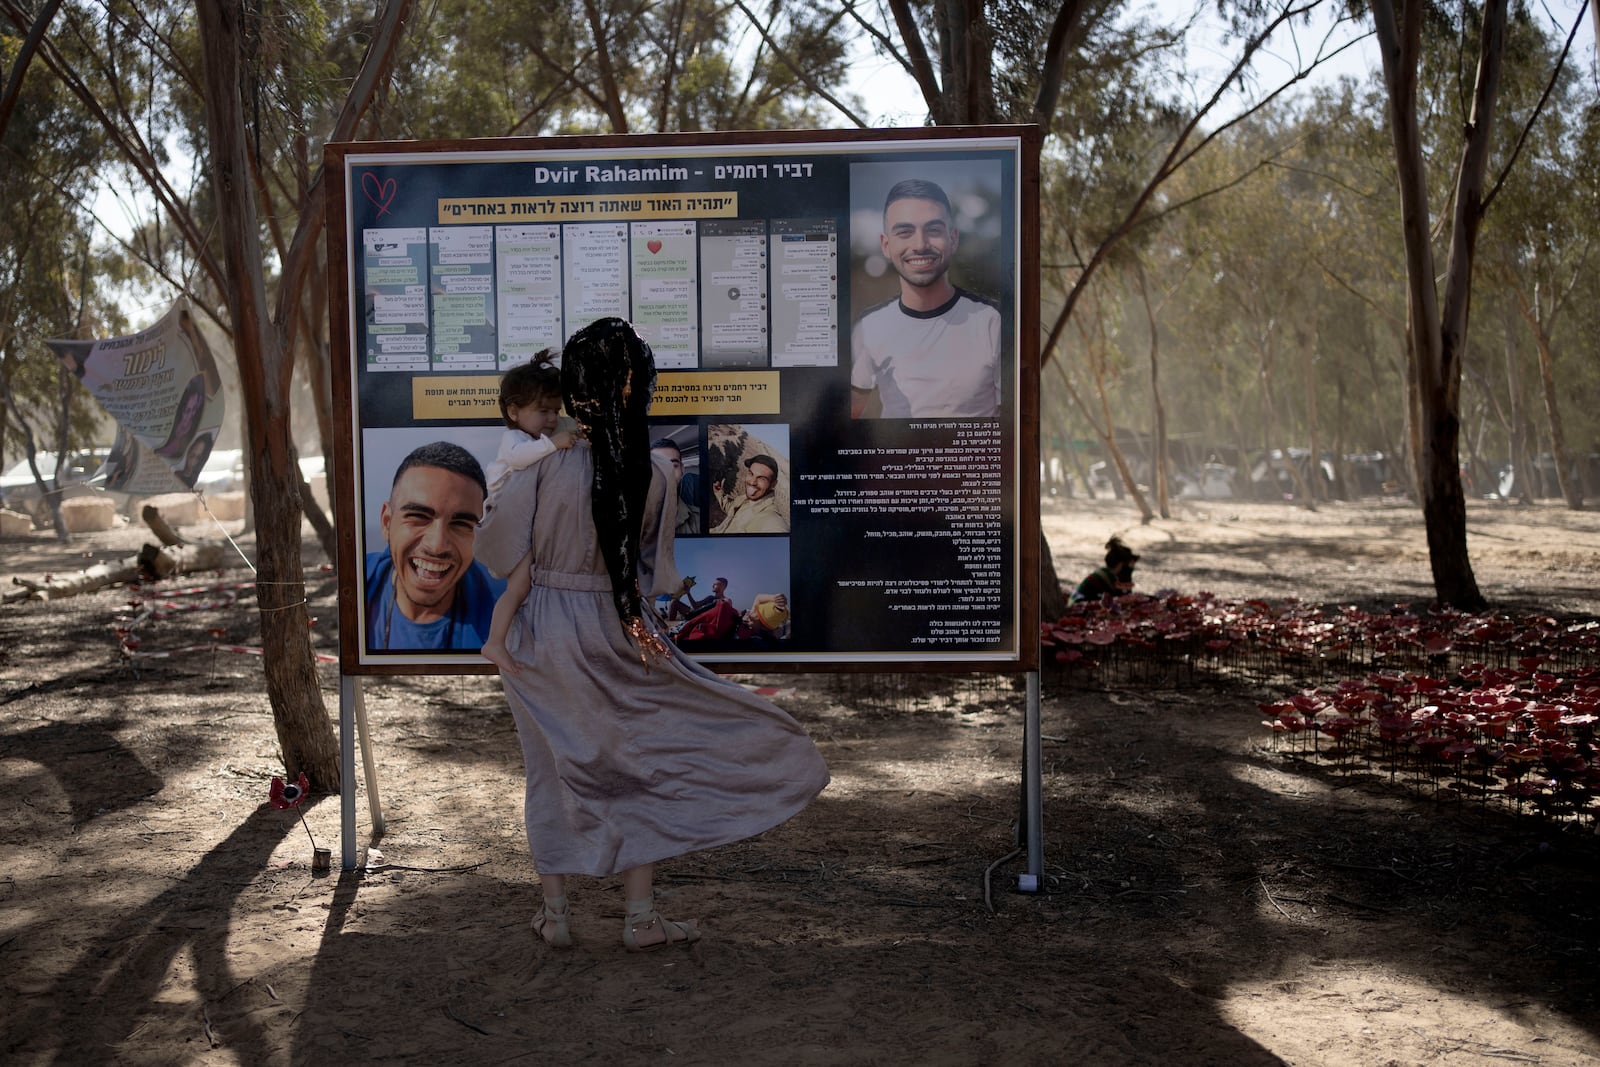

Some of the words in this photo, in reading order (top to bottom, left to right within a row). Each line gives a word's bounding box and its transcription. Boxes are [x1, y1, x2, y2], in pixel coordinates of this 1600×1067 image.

[535, 167, 579, 184] Dvir
[585, 164, 688, 182] Rahamim
[714, 164, 767, 179] רחמים
[773, 163, 813, 178] דביר
[443, 203, 506, 216] באחרים"
[511, 199, 555, 214] לראות
[560, 201, 594, 213] רוצה
[599, 200, 642, 212] שאתה
[647, 199, 681, 211] האור
[687, 198, 732, 210] "תהיה
[478, 388, 501, 396] צועות
[473, 398, 496, 406] להציל
[665, 395, 689, 403] להכנס
